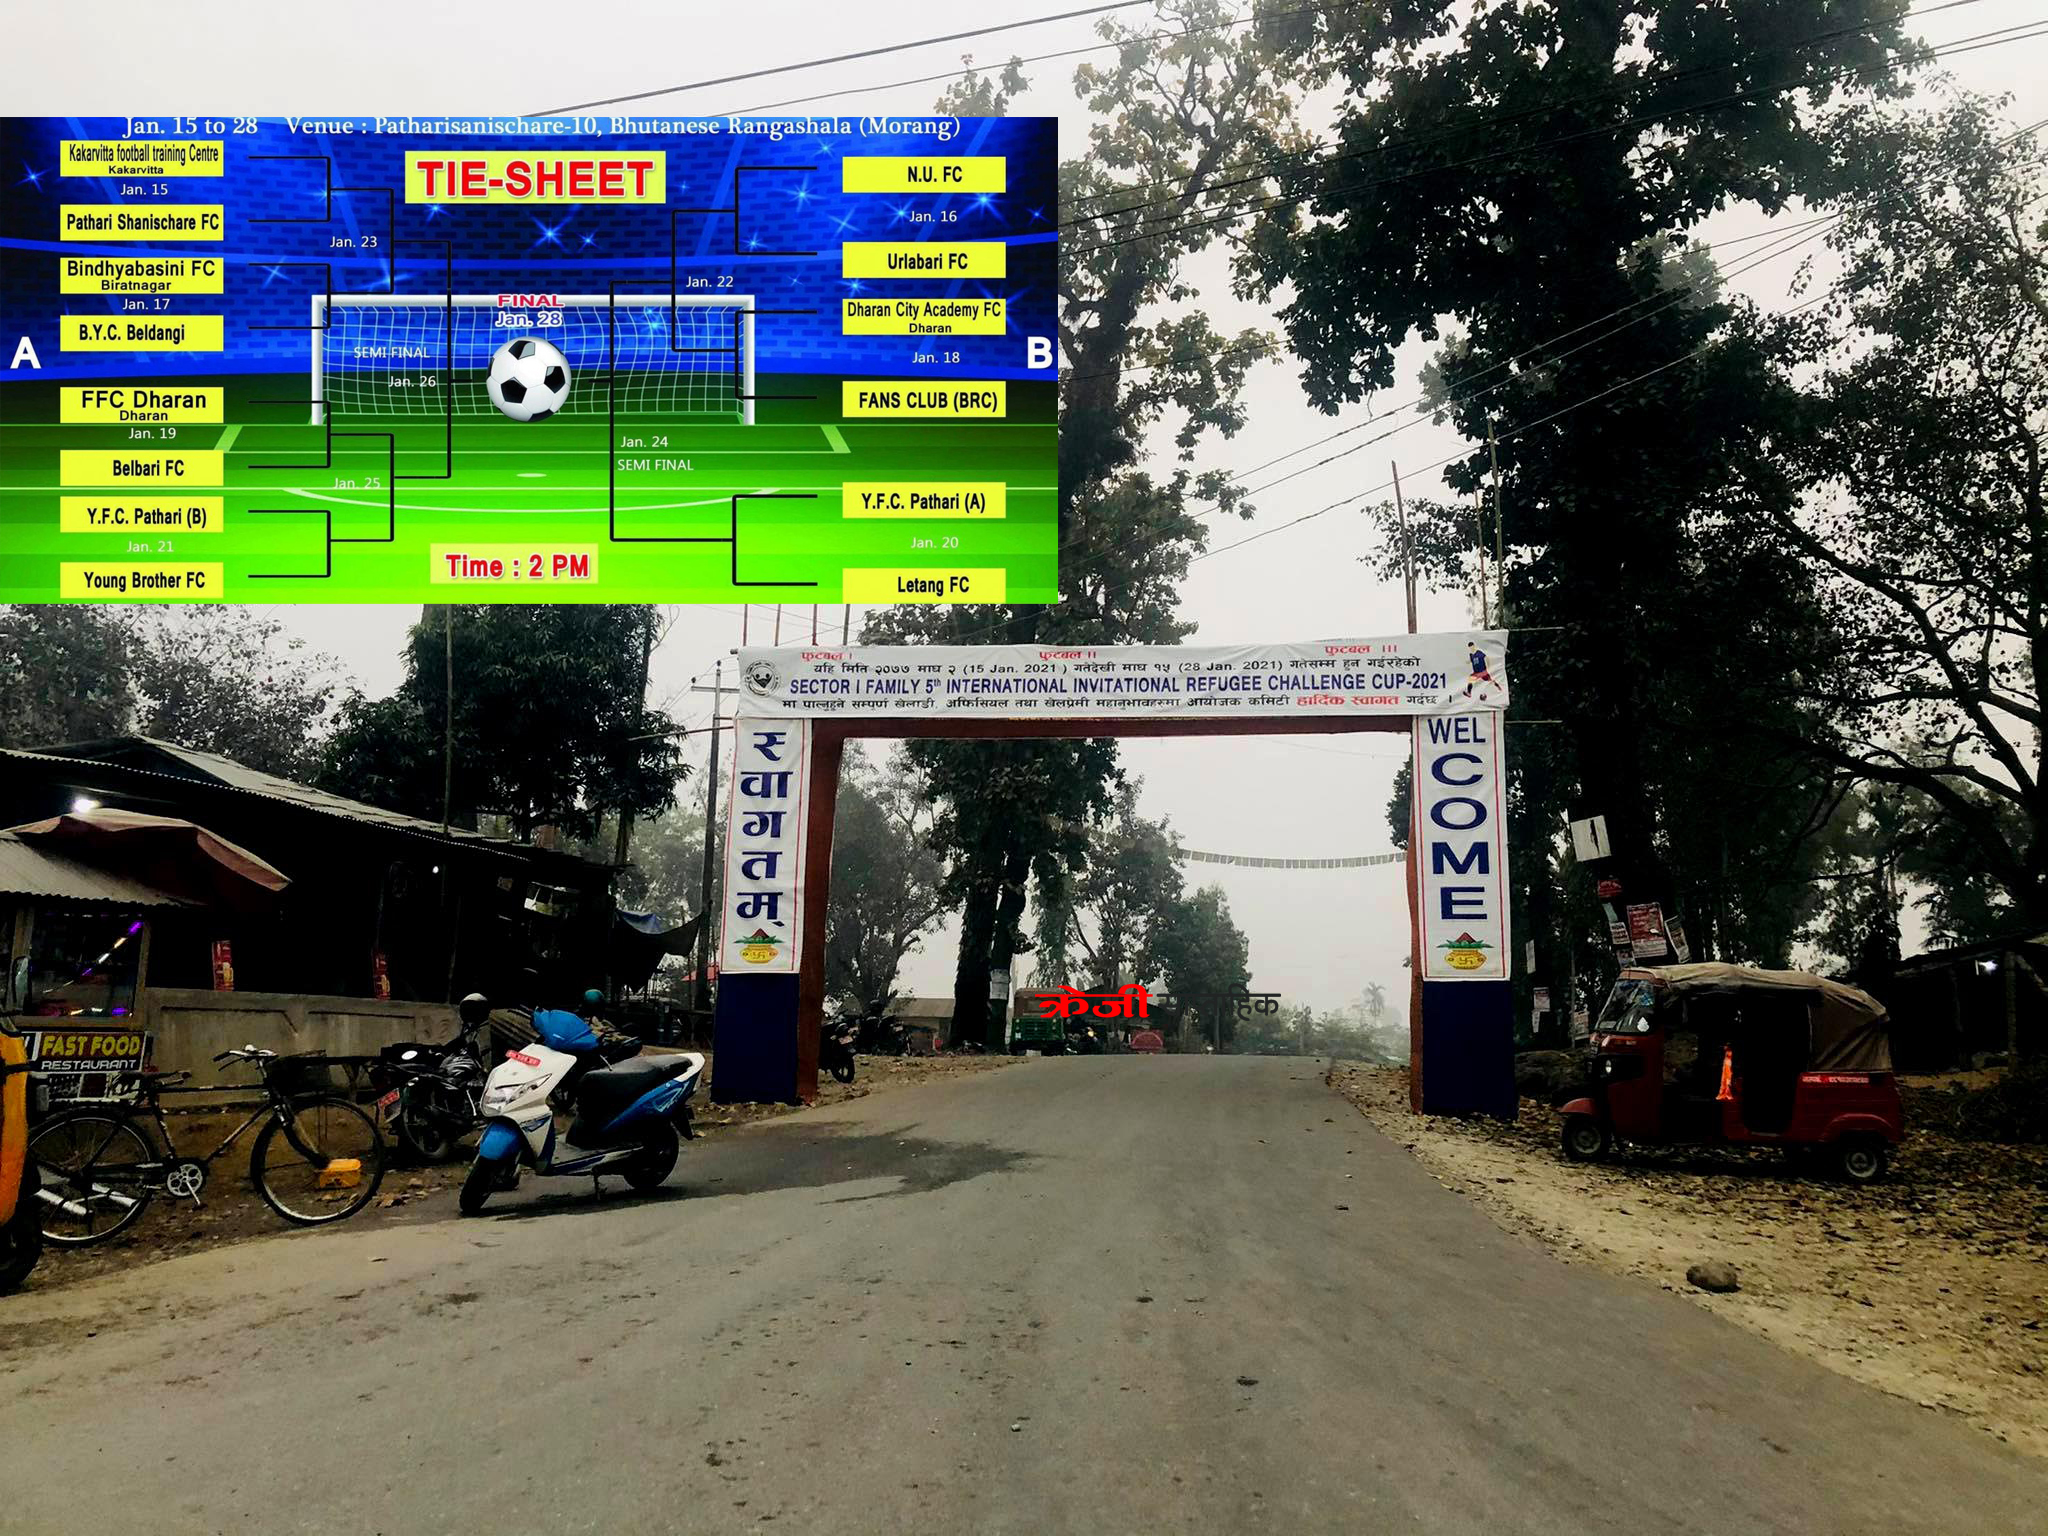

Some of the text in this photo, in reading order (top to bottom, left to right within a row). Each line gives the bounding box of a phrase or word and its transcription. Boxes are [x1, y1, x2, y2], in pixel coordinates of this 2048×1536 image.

[801, 652, 843, 661] फुटबल
[1040, 651, 1082, 660] फुटबल
[1325, 645, 1371, 656] फुटबल
[842, 662, 868, 673] मिति
[875, 665, 910, 675] २०७७
[917, 665, 941, 673] माघ
[963, 664, 984, 675] (15
[990, 664, 1018, 674] Jan.
[1024, 664, 1056, 673] 2021
[1122, 663, 1147, 672] माघ
[1179, 663, 1200, 673] (28
[1206, 663, 1236, 671] Jan.
[1290, 659, 1336, 670] गतेसम्म
[1343, 659, 1360, 671] हुन
[790, 679, 850, 695] SECTOR
[866, 679, 920, 694] FAMILY
[946, 678, 1067, 694] INTERNATIONAL
[1073, 676, 1180, 693] INVITATIONAL
[1186, 675, 1262, 692] REFUGEE
[1268, 674, 1366, 691] CHALLENGE
[1372, 673, 1448, 690] CUP-2021
[782, 700, 796, 709] मा
[946, 697, 1008, 709] अफिसियल
[1014, 699, 1037, 708] तथा
[1187, 696, 1242, 707] आयोजक
[1248, 695, 1290, 705] कमिटी
[1296, 693, 1346, 706] हार्दिक
[1351, 695, 1401, 706] स्वागत
[42, 1036, 141, 1056] FAST FOOD
[41, 1060, 137, 1070] RESTAURANT
